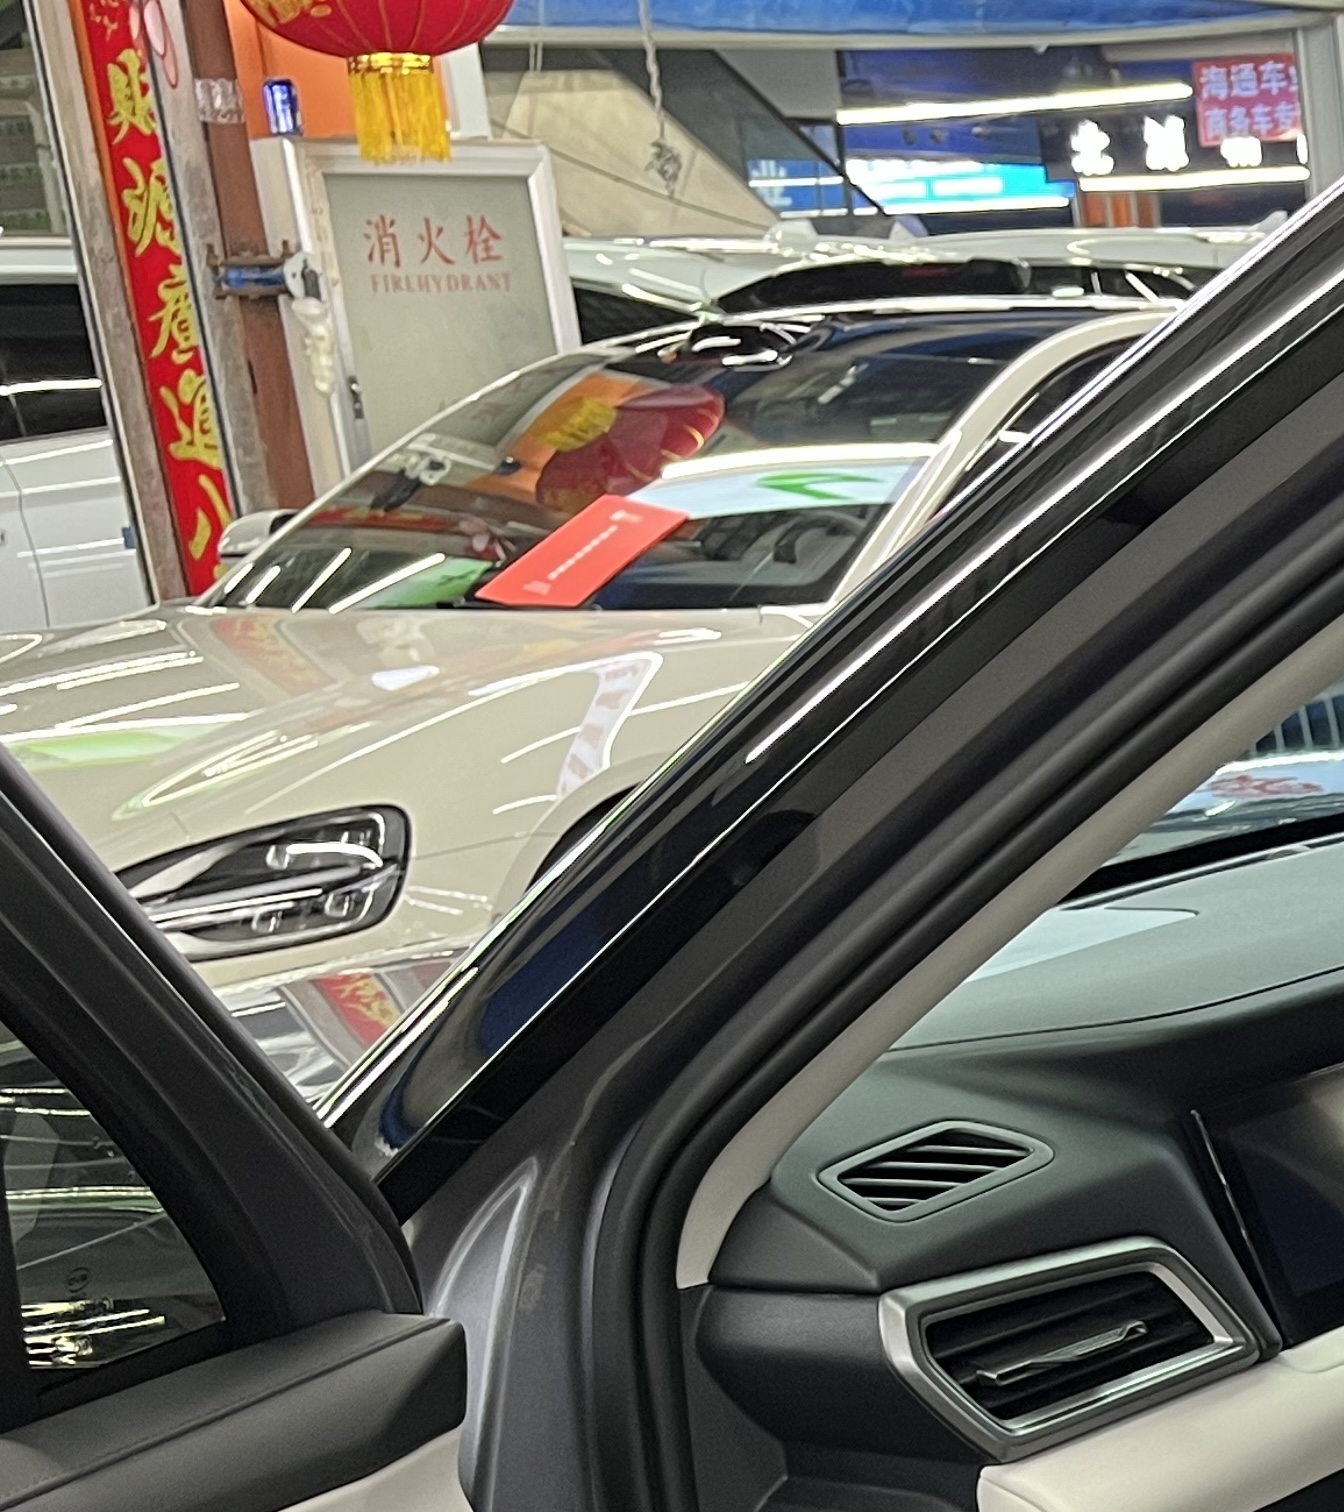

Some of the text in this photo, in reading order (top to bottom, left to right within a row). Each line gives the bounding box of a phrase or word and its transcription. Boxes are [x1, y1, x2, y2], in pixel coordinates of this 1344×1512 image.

[1200, 60, 1299, 101] 海通车
[362, 213, 504, 269] 消火栓
